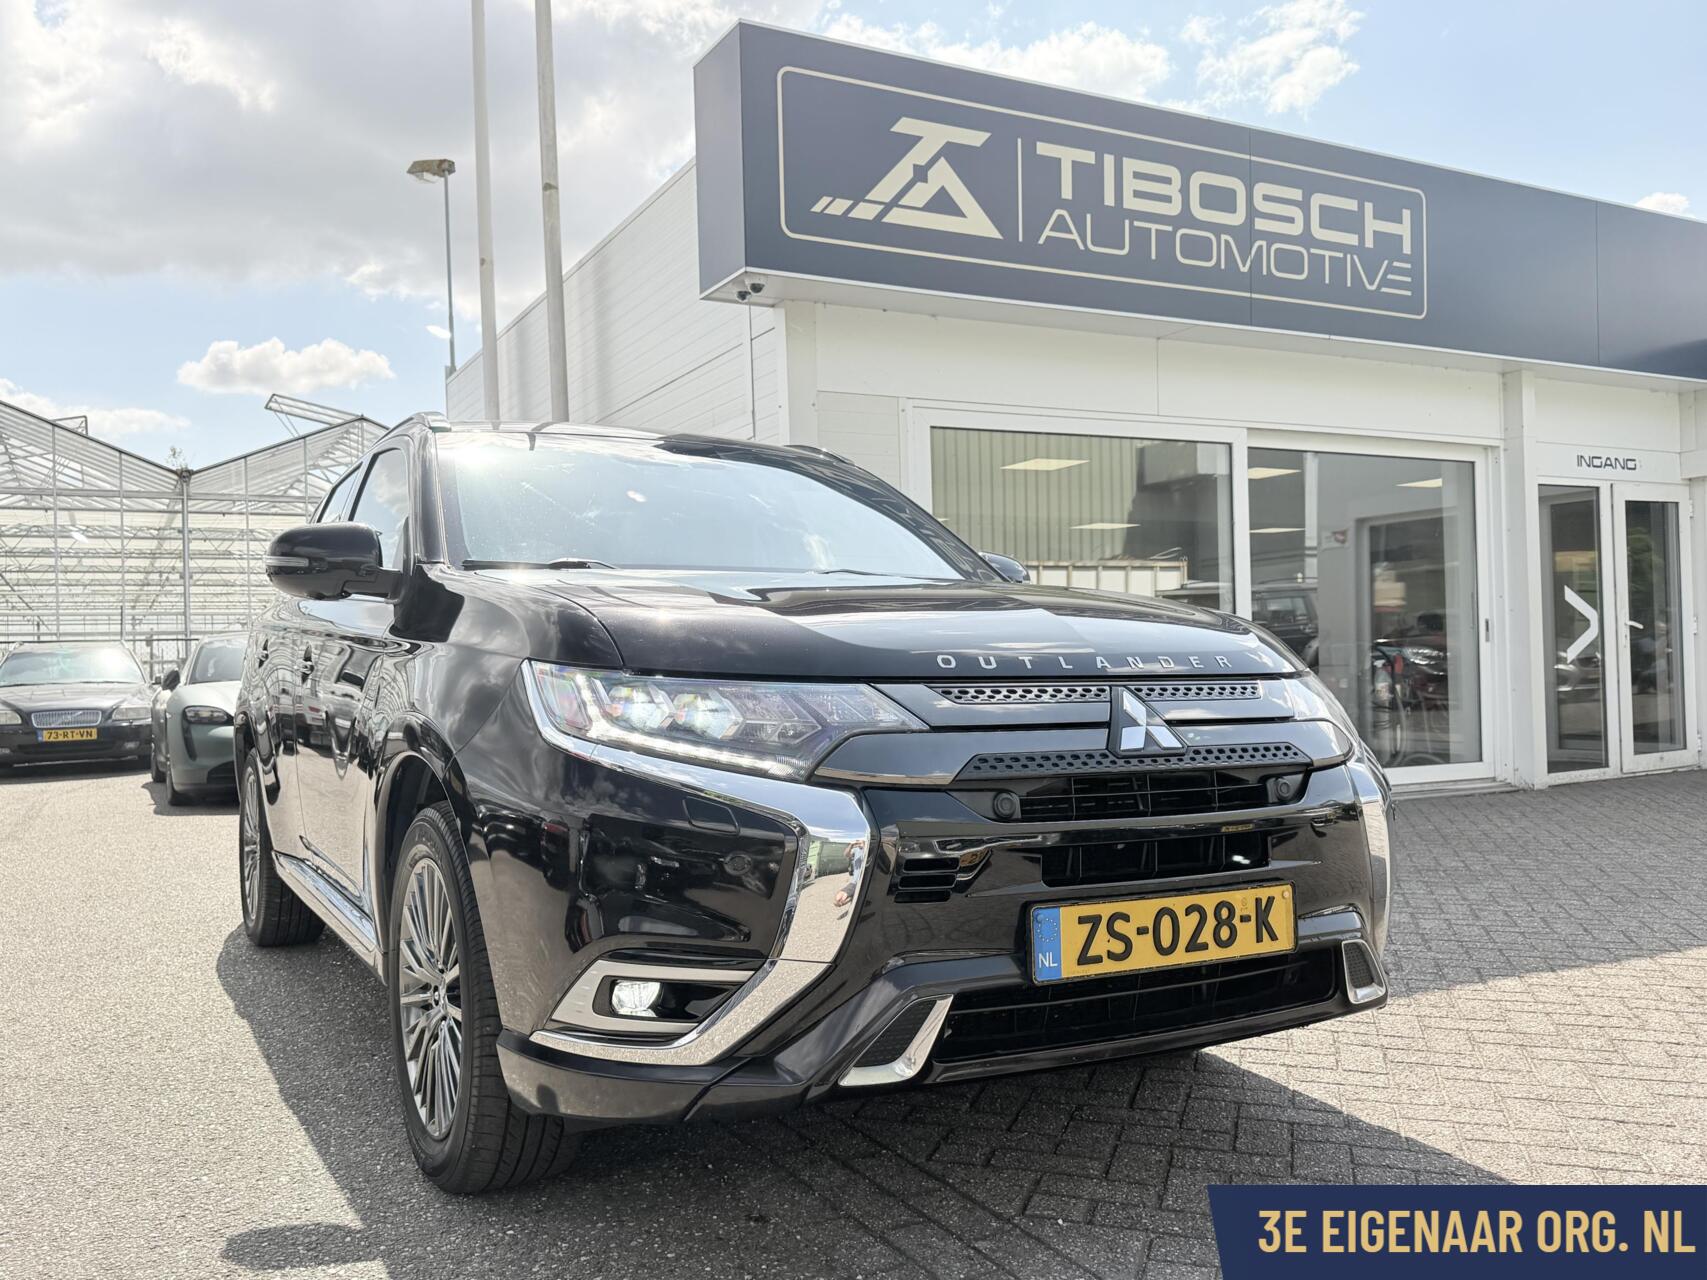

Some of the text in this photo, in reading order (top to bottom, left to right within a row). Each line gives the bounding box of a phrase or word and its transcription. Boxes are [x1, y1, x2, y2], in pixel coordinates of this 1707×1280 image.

[1036, 141, 1412, 255] TIBOSCH
[1037, 208, 1412, 297] AUTOMOTIVE
[1576, 454, 1637, 471] INGANG
[936, 654, 1233, 670] OUTLANDER
[1077, 895, 1279, 967] ZS-028-K
[1038, 951, 1058, 969] NL
